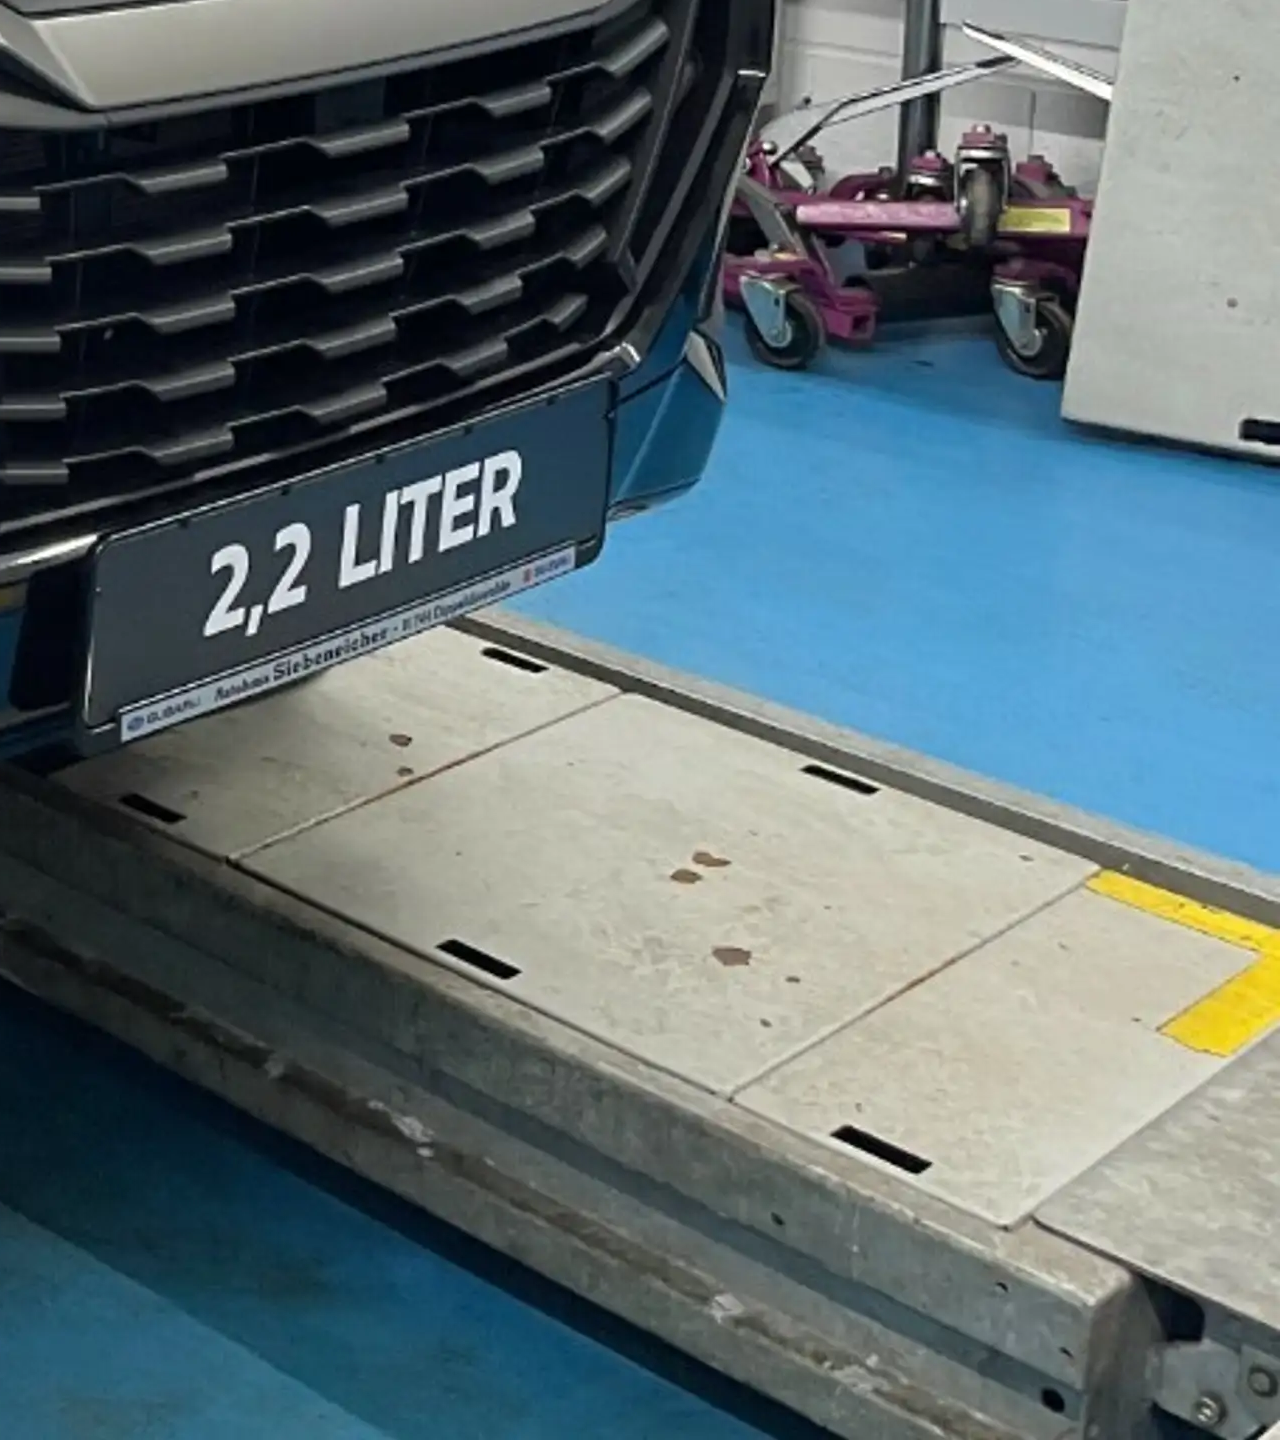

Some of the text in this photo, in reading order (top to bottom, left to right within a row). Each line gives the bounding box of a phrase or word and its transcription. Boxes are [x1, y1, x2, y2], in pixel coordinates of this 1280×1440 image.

[203, 449, 524, 638] 2,2 LITER
[273, 626, 390, 682] Siebeneicher
